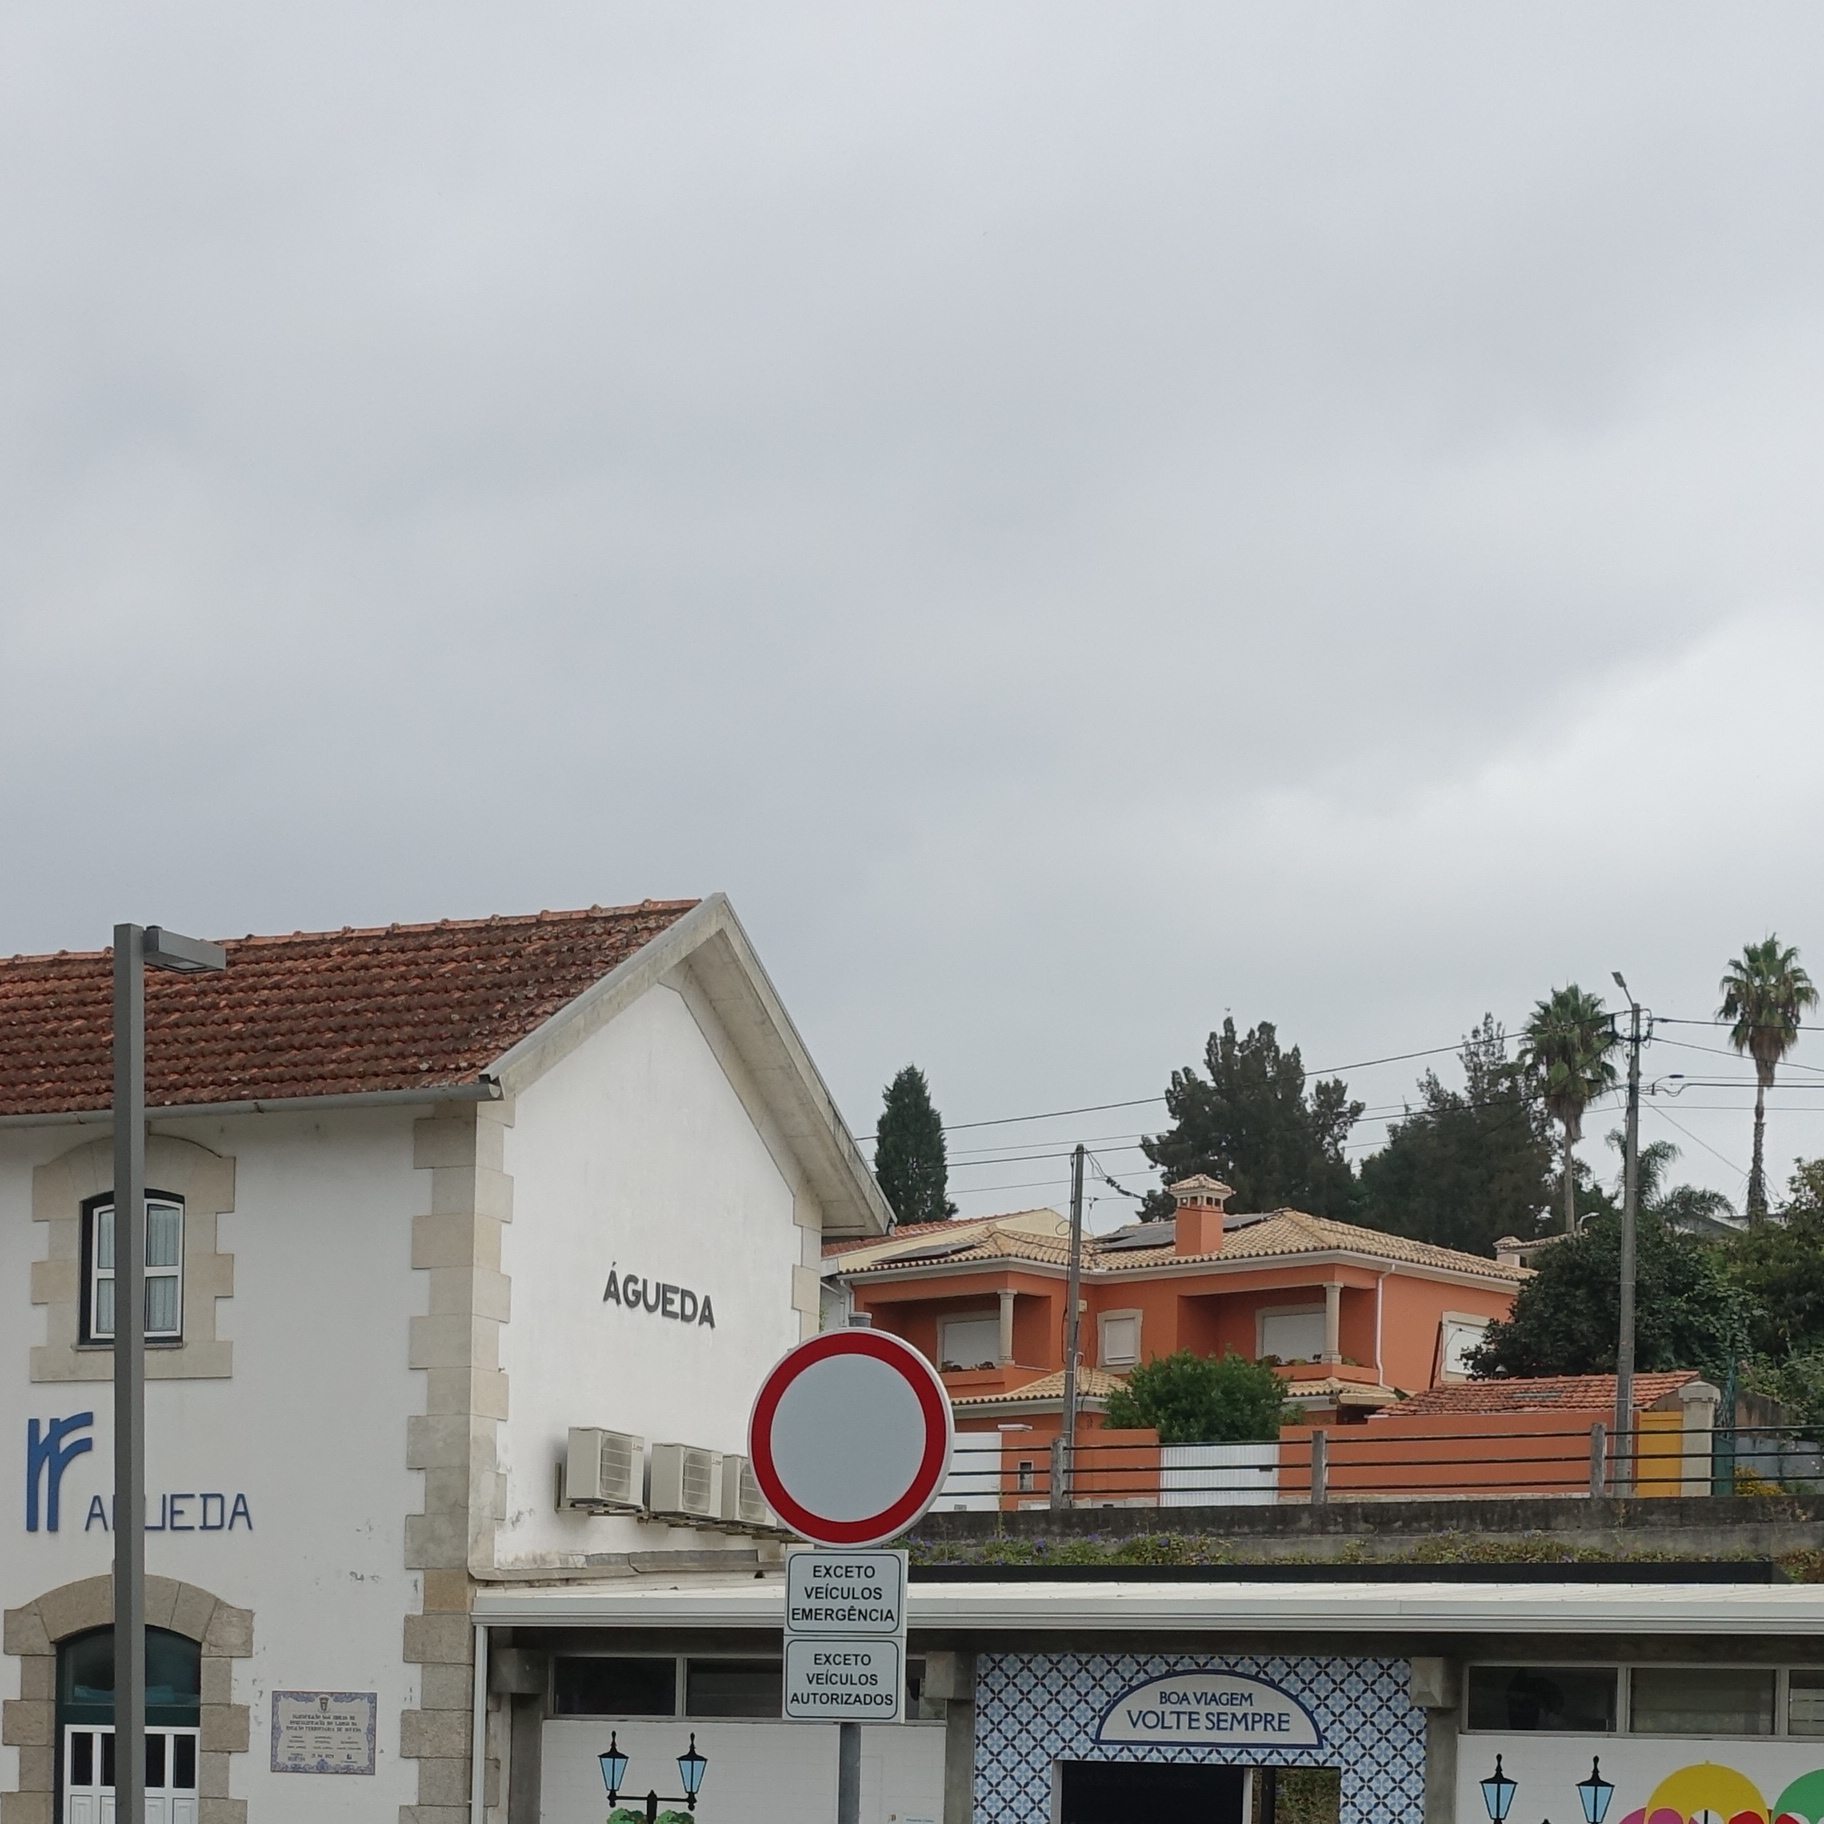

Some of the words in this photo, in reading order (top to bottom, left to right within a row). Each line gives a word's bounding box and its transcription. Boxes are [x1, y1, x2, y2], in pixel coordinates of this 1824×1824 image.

[603, 1261, 716, 1329] ÁGUEDA
[84, 1493, 253, 1531] AUEDA
[812, 1565, 876, 1579] EXCETO
[804, 1583, 883, 1601] VEÍCULOS
[791, 1605, 895, 1622] EMERGÊNCIA
[813, 1653, 872, 1666] EXCETO
[806, 1669, 878, 1686] VEÍCULOS
[790, 1692, 894, 1706] AUTORIZADOS
[1159, 1691, 1190, 1706] BOA
[1192, 1692, 1254, 1707] VIAGEM
[1126, 1709, 1200, 1730] VOLTE
[1205, 1711, 1291, 1732] SEMPRE
